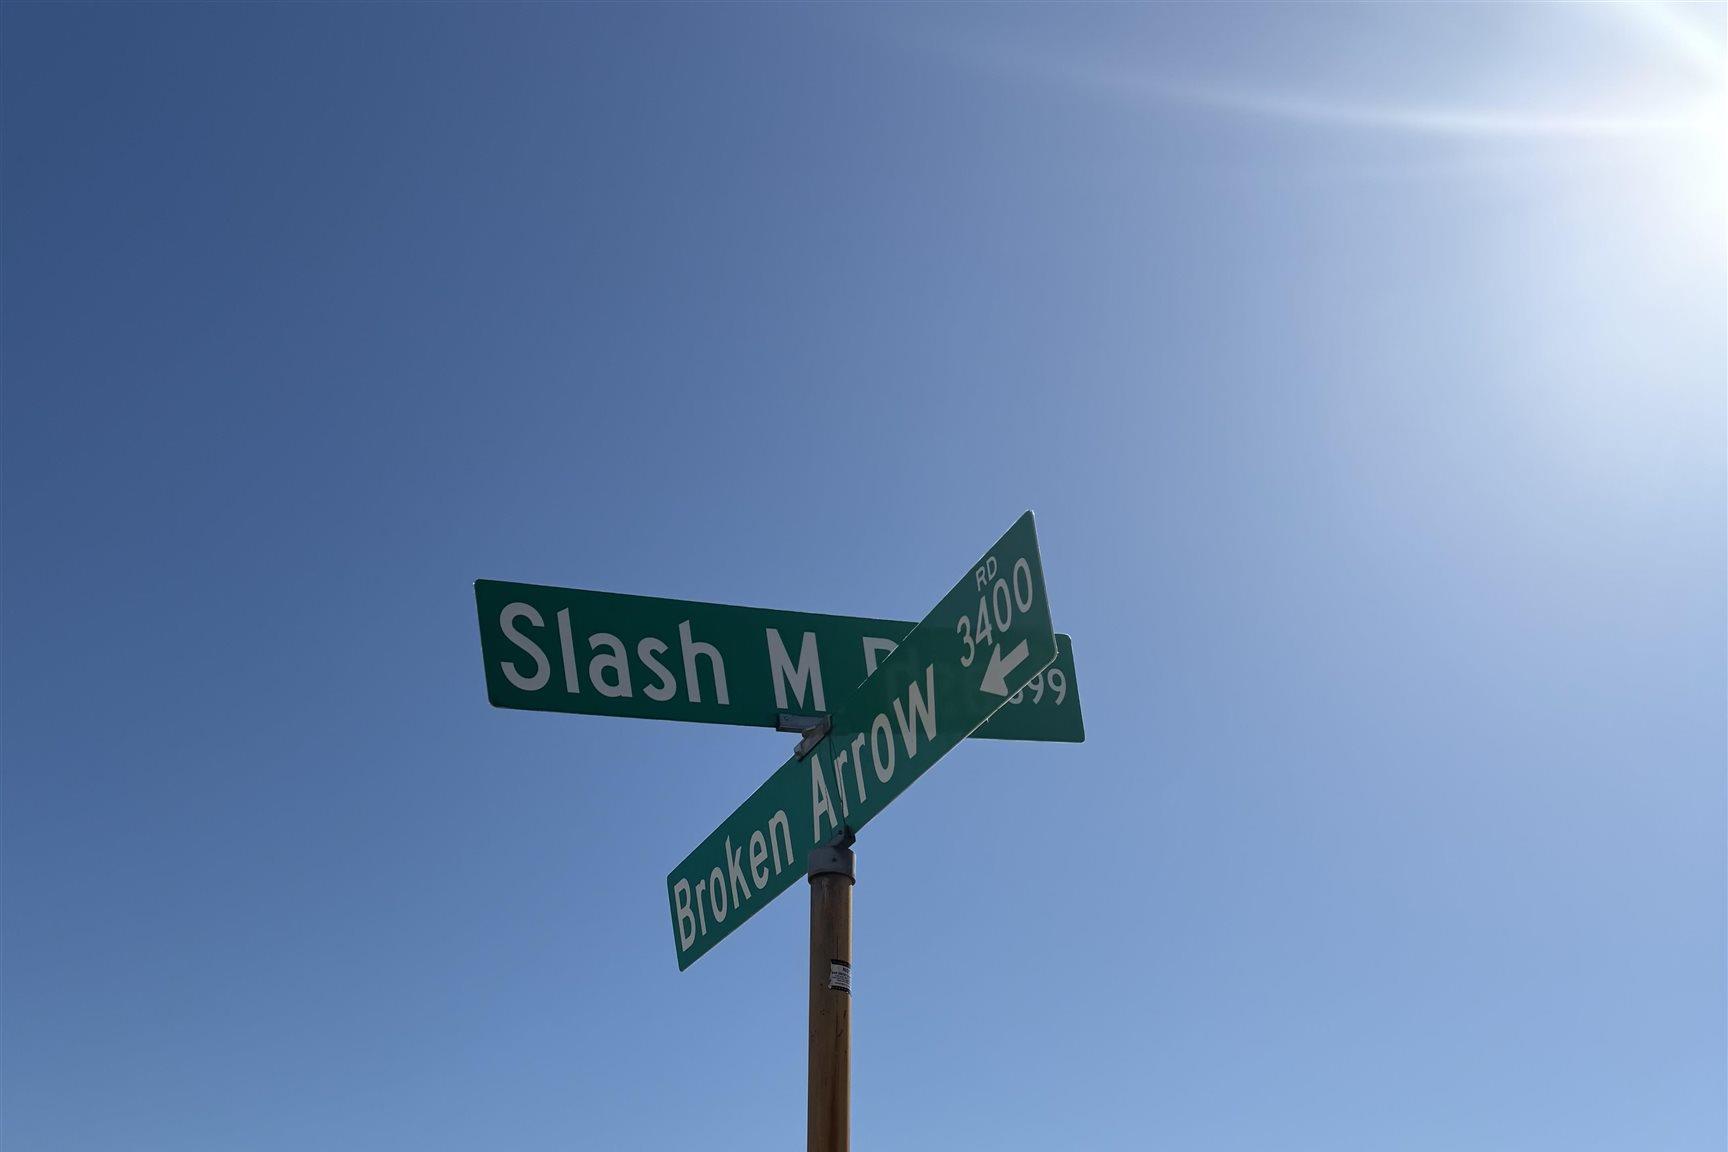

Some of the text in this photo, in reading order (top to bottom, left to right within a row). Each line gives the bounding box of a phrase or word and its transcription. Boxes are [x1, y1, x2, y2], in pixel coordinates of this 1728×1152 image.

[956, 557, 1034, 668] 3400
[975, 556, 998, 591] RD
[499, 601, 731, 706] Slash
[765, 627, 827, 713] M
[673, 663, 938, 953] Broken Arrow
